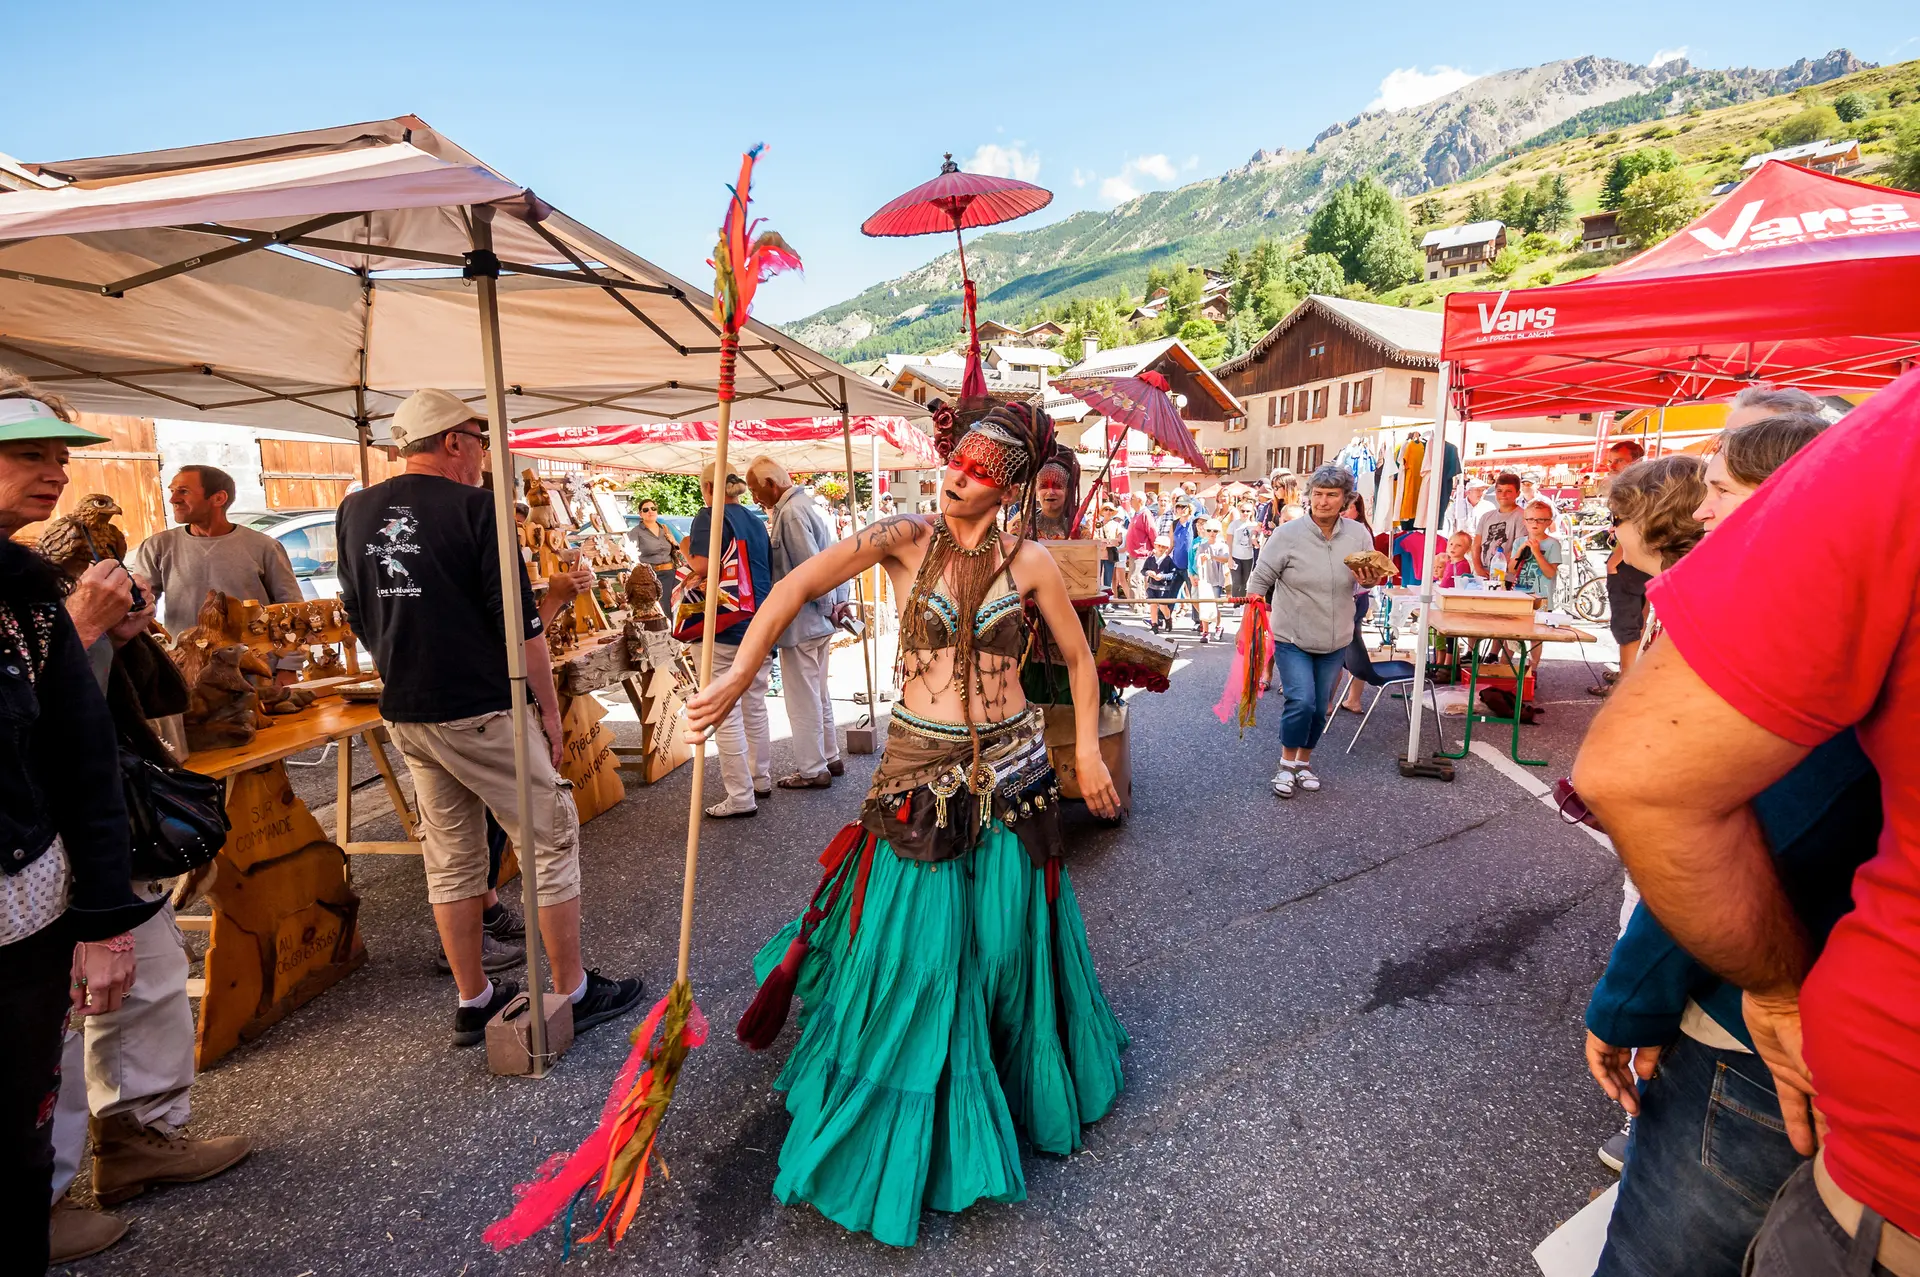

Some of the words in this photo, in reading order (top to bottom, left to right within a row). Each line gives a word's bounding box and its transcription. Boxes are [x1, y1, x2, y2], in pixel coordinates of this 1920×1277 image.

[1688, 199, 1909, 251] Vars
[1703, 250, 1734, 259] LA
[1813, 221, 1920, 239] BLANCHE
[1477, 289, 1557, 334] Vars
[1516, 330, 1556, 340] BLANCHE
[653, 689, 673, 746] Fabrication
[659, 712, 678, 767] Artisanale
[251, 801, 273, 823] SUR
[236, 815, 294, 853] COMMANDE
[279, 934, 293, 954] AU
